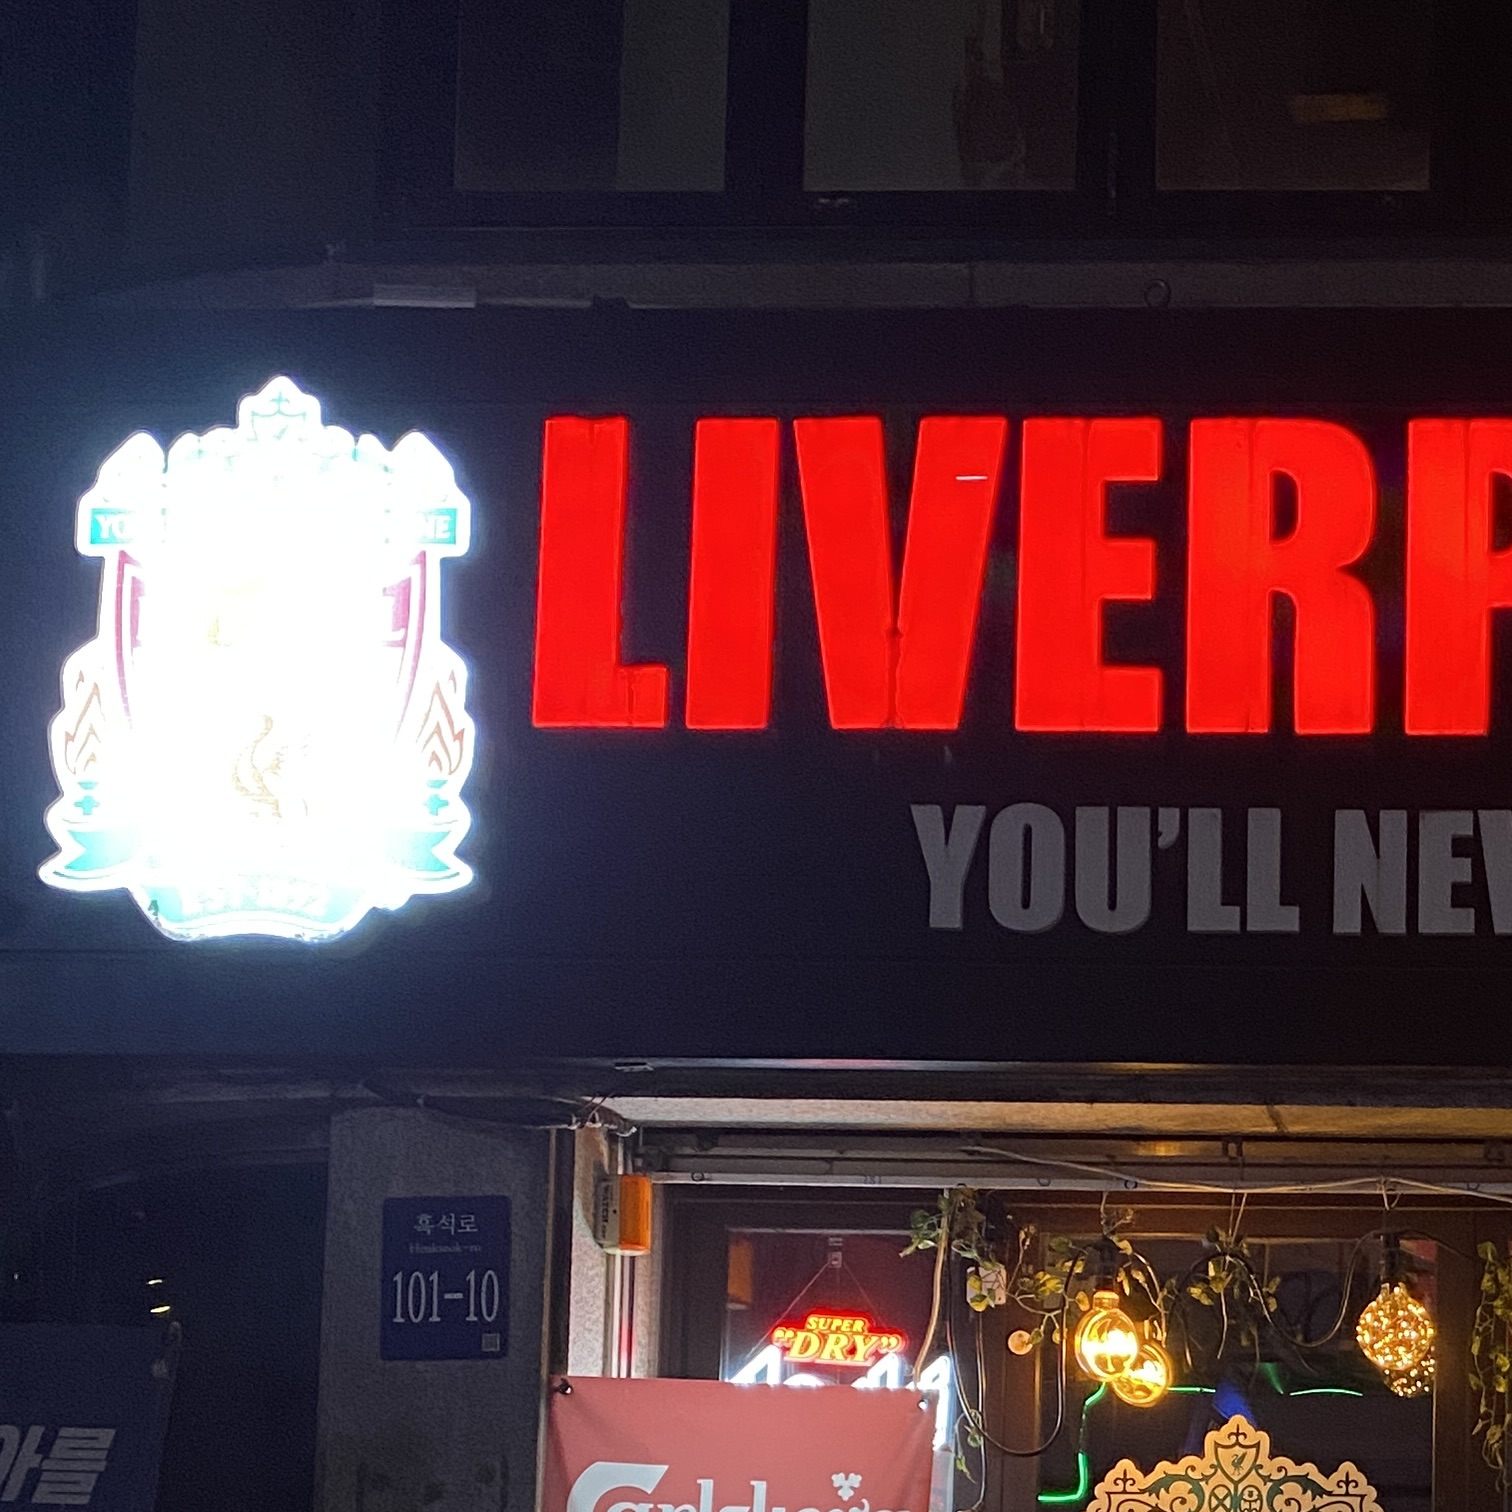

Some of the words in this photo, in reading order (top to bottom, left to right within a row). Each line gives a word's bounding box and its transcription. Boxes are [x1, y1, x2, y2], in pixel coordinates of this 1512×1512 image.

[909, 802, 1299, 934] YOU'LL
[414, 1212, 479, 1235] 흑석로
[392, 1269, 500, 1324] 101-10
[806, 1316, 866, 1333] SUPER
